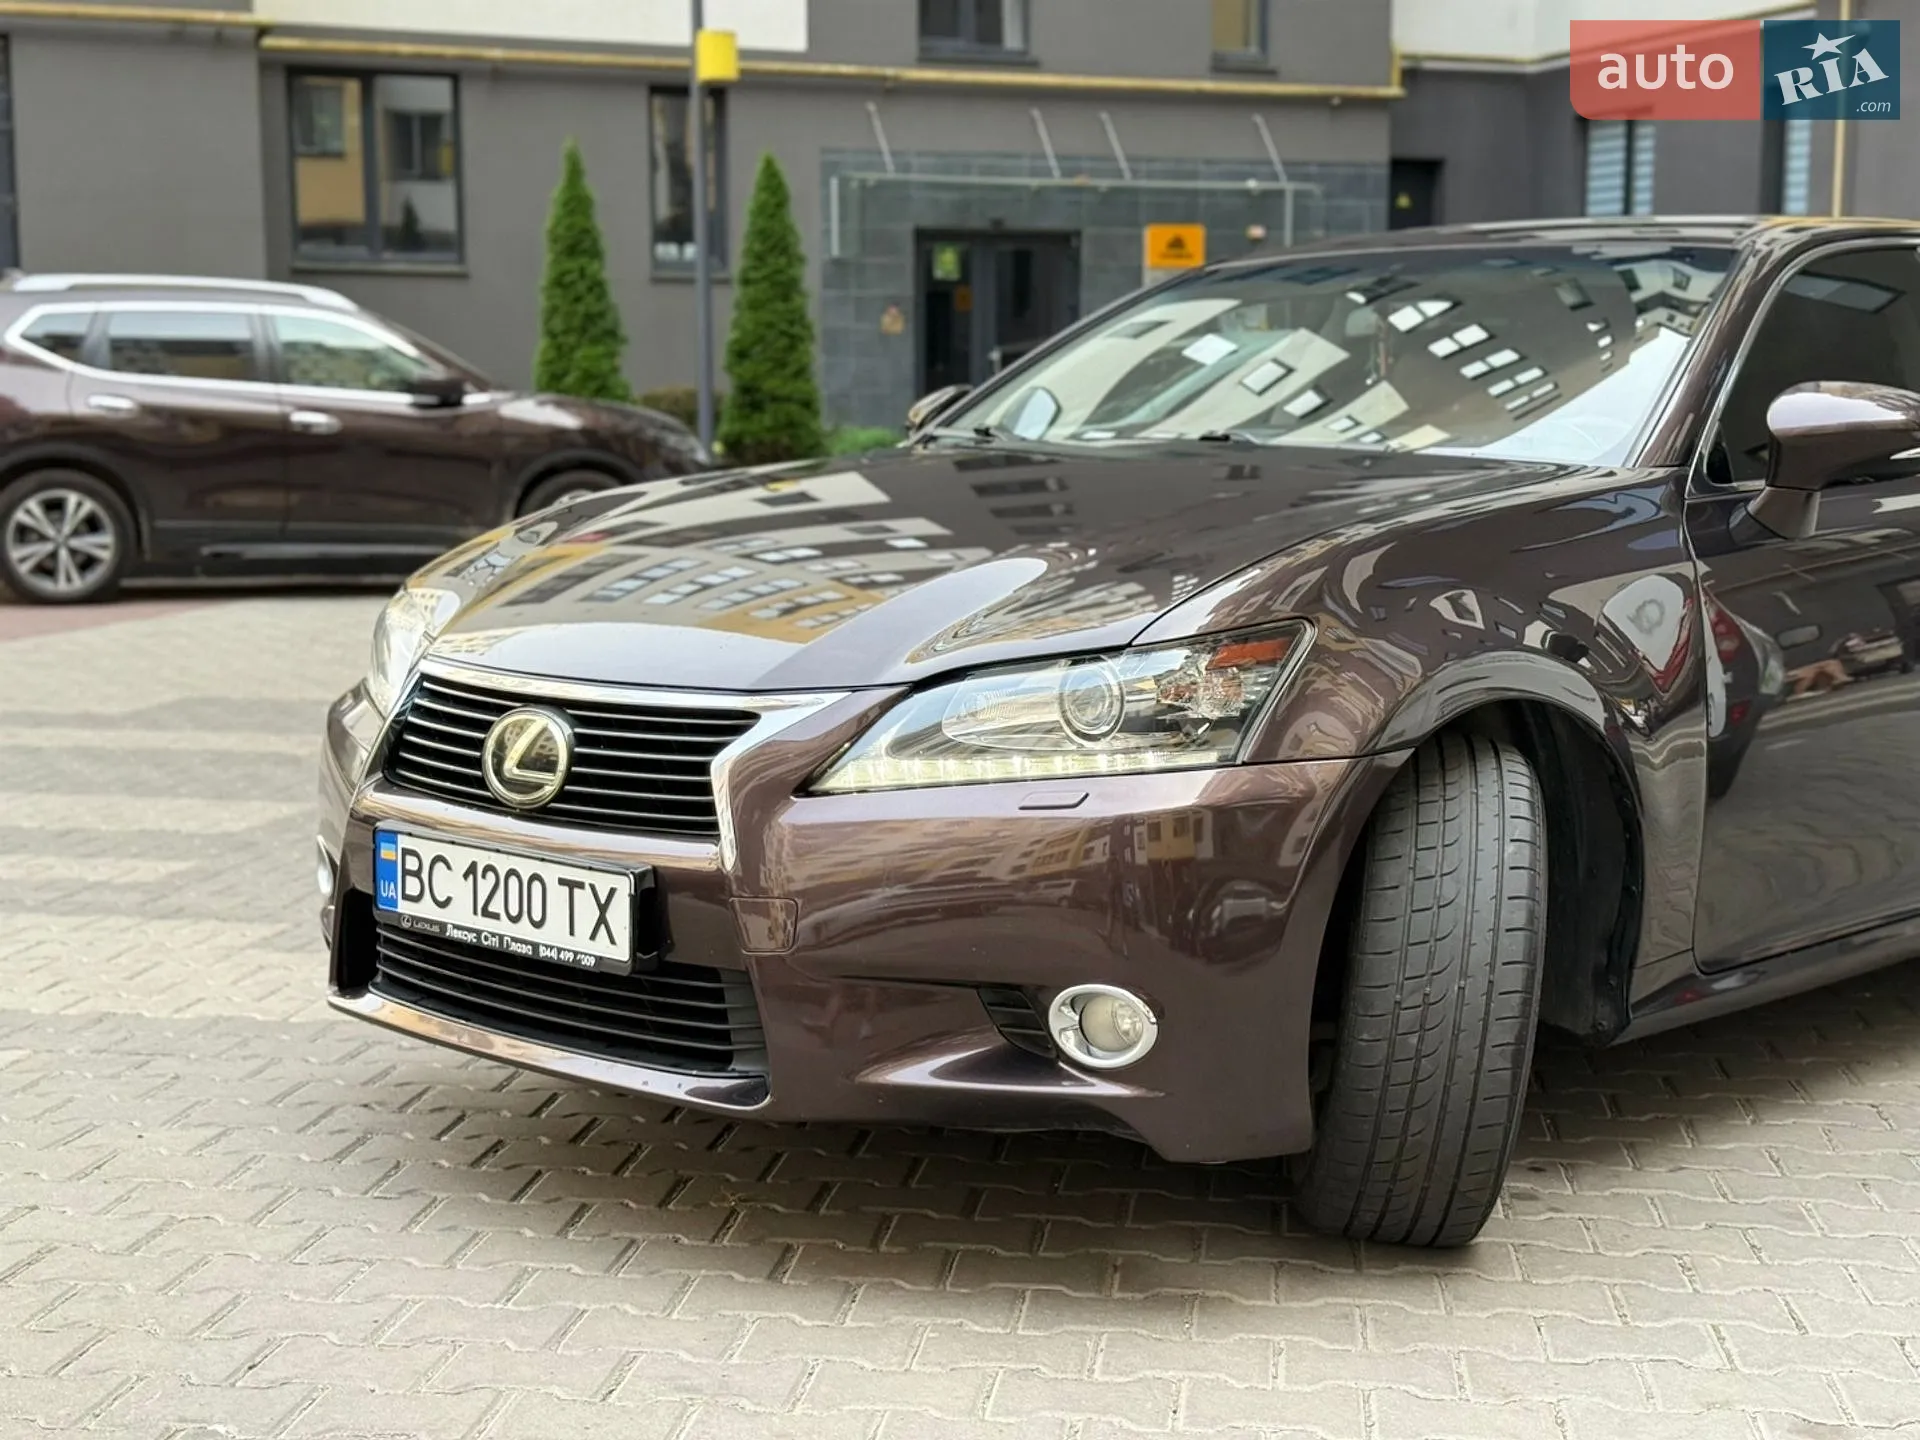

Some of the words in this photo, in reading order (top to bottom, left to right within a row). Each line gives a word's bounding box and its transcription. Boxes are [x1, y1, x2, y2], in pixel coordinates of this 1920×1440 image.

[381, 880, 397, 900] UA
[401, 847, 453, 909] BC
[462, 860, 547, 930] 1200
[557, 877, 618, 946] TX
